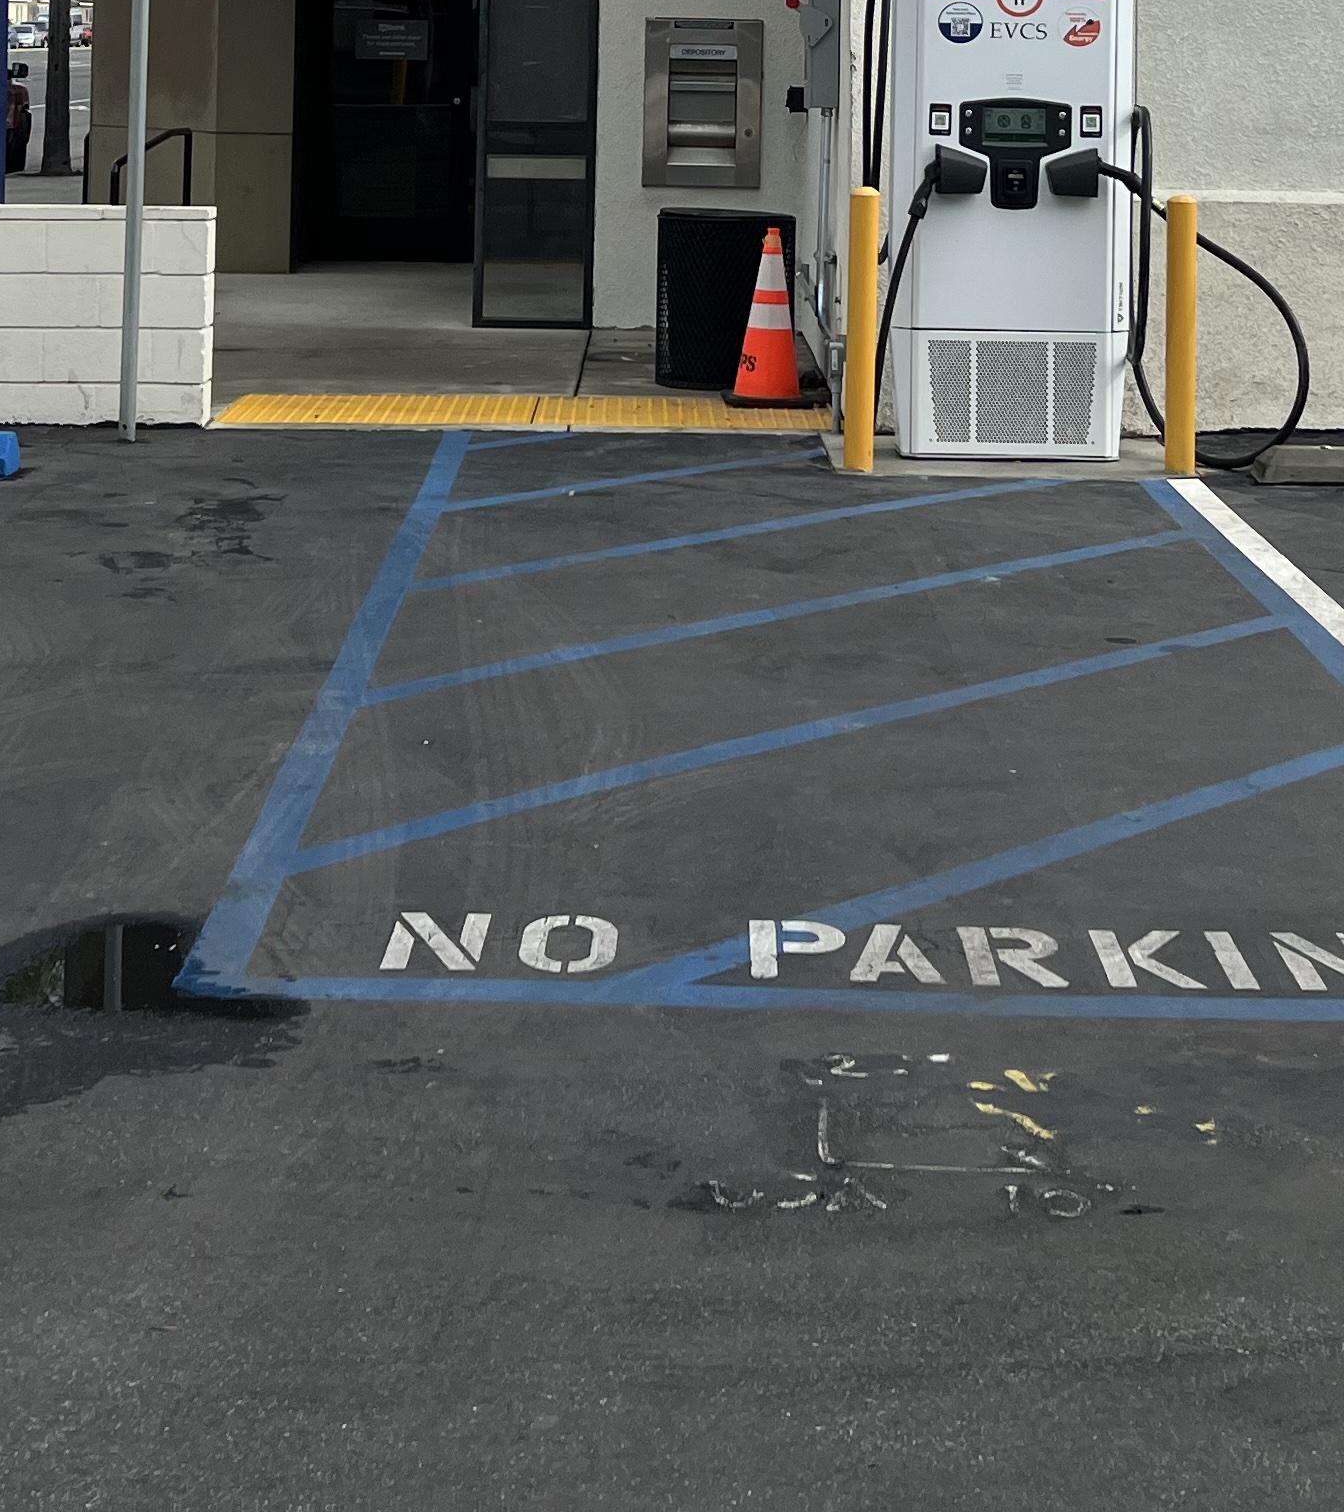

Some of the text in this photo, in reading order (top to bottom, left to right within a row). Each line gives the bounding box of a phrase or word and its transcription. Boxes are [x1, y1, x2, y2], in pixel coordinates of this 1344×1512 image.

[989, 22, 1048, 40] EVCS
[681, 48, 726, 56] DEPOSITORY
[378, 911, 619, 974] NO
